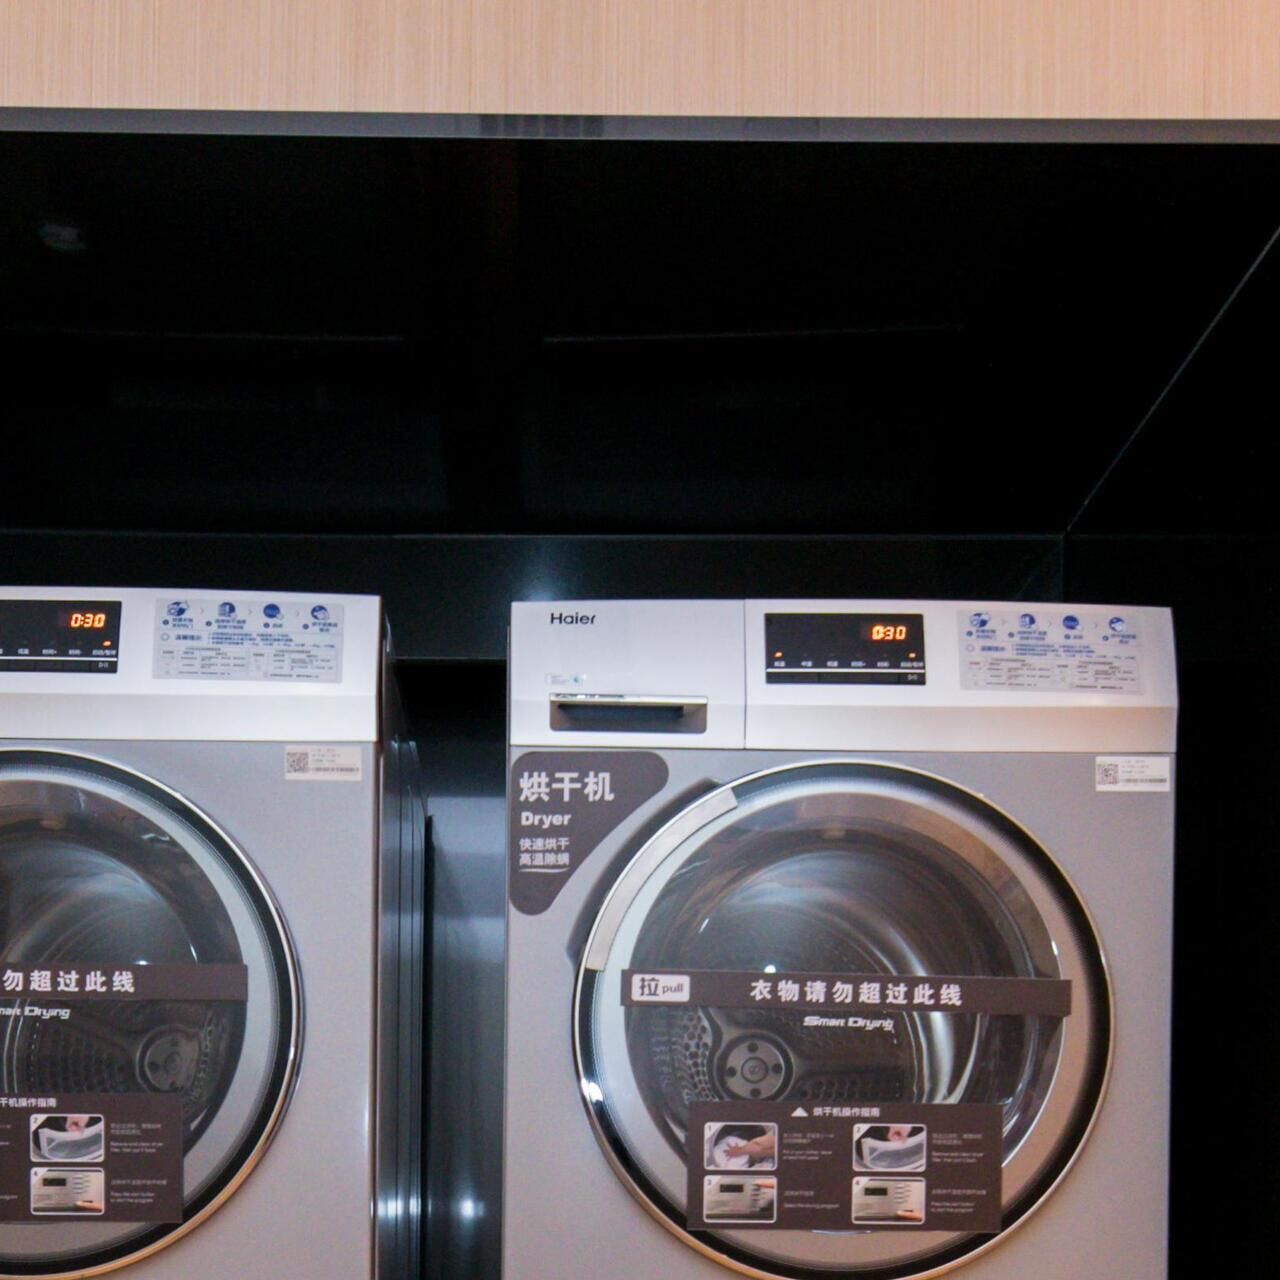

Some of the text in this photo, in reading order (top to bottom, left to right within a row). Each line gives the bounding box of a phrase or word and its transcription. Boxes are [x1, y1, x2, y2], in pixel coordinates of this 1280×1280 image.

[70, 613, 106, 628] 0:30
[550, 612, 596, 625] Haier
[519, 771, 614, 802] 烘干机
[520, 812, 572, 828] Dryer
[519, 838, 570, 851] 快速烘干
[638, 976, 685, 997] 拉 pull
[750, 980, 963, 1006] 衣物请勿超过此线
[812, 1106, 880, 1118] 烘干机操作指南
